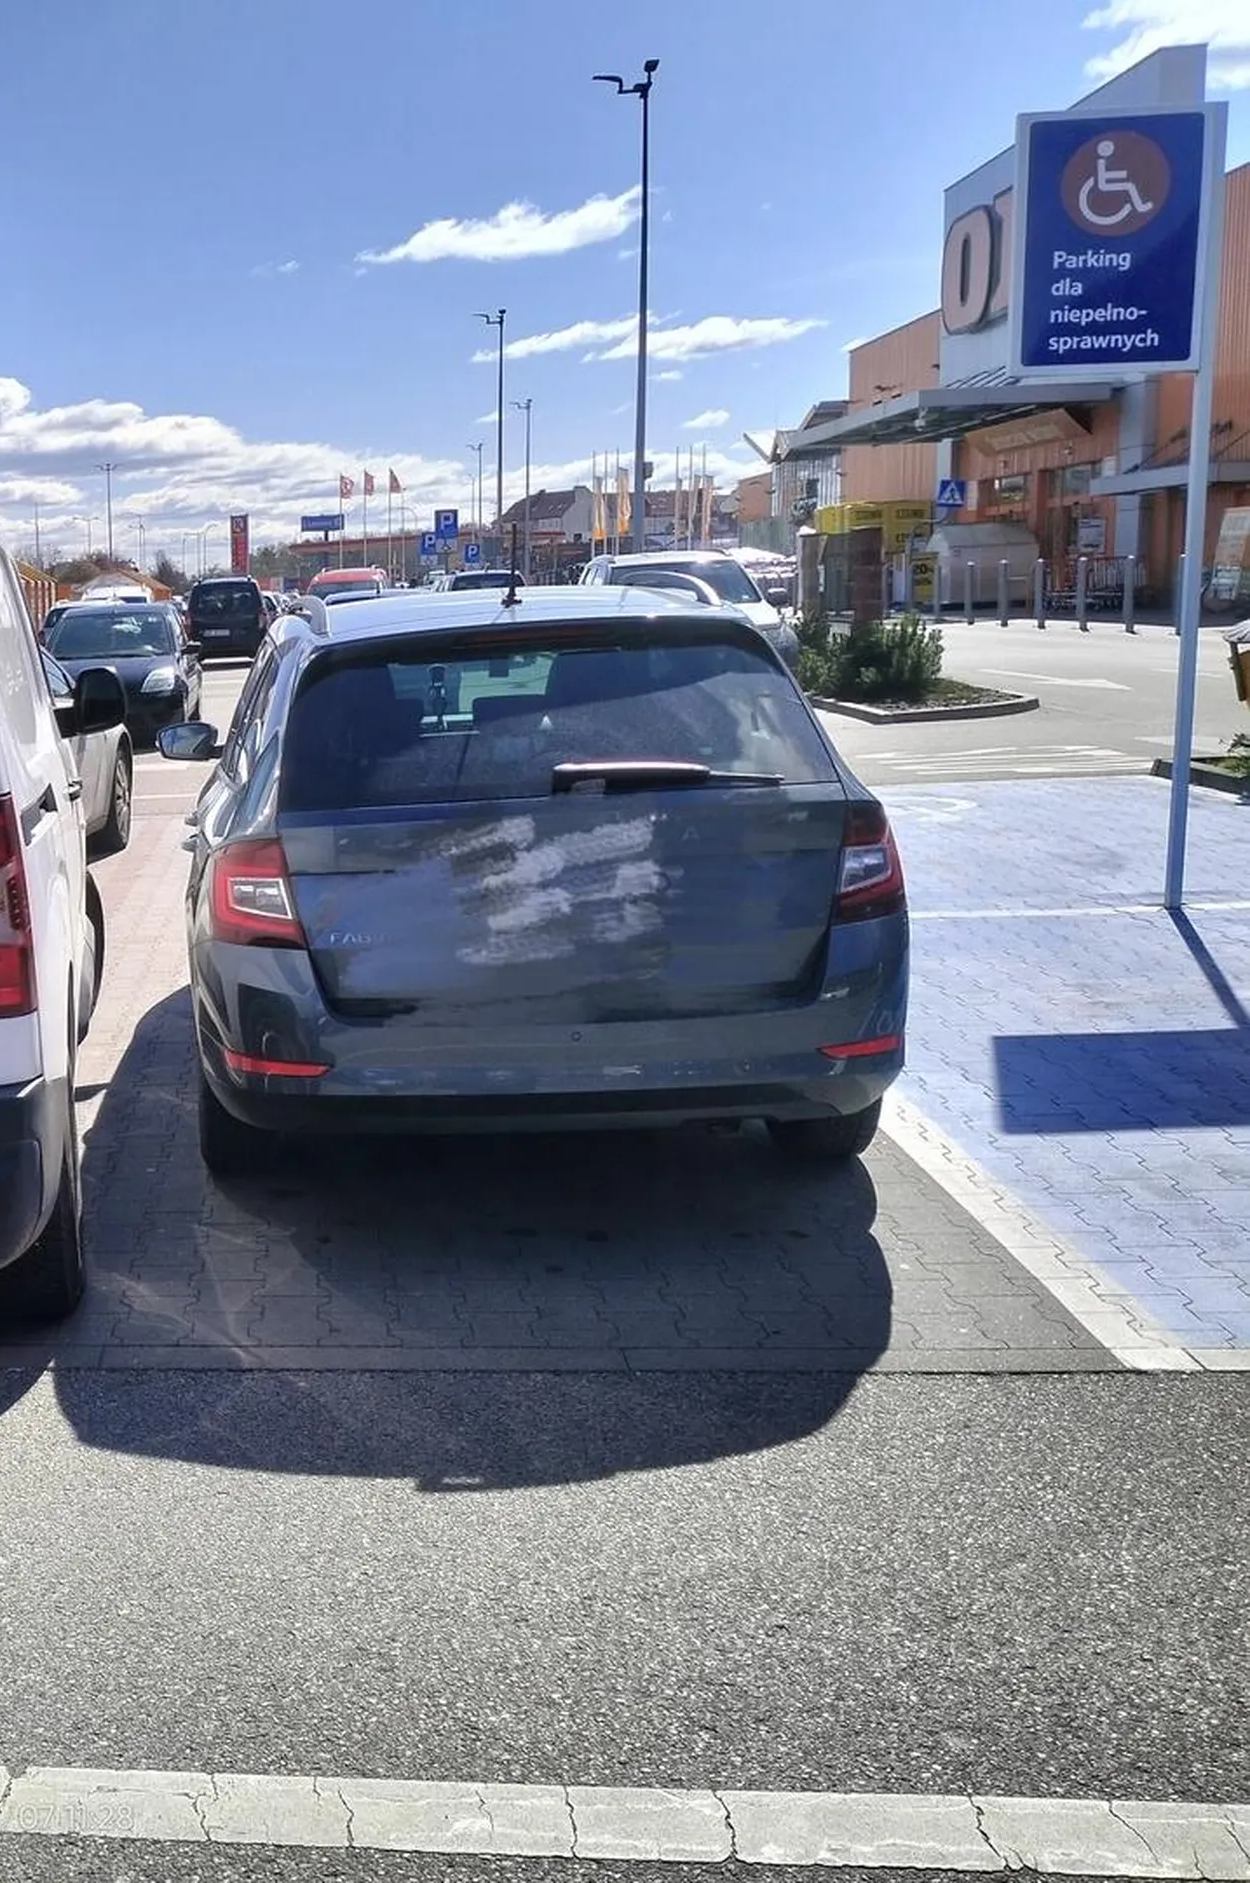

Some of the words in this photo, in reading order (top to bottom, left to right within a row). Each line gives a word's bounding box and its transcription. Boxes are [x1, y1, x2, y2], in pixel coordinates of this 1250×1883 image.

[1053, 249, 1131, 271] Parking
[1051, 278, 1083, 296] dla
[1049, 328, 1159, 354] sprawnych
